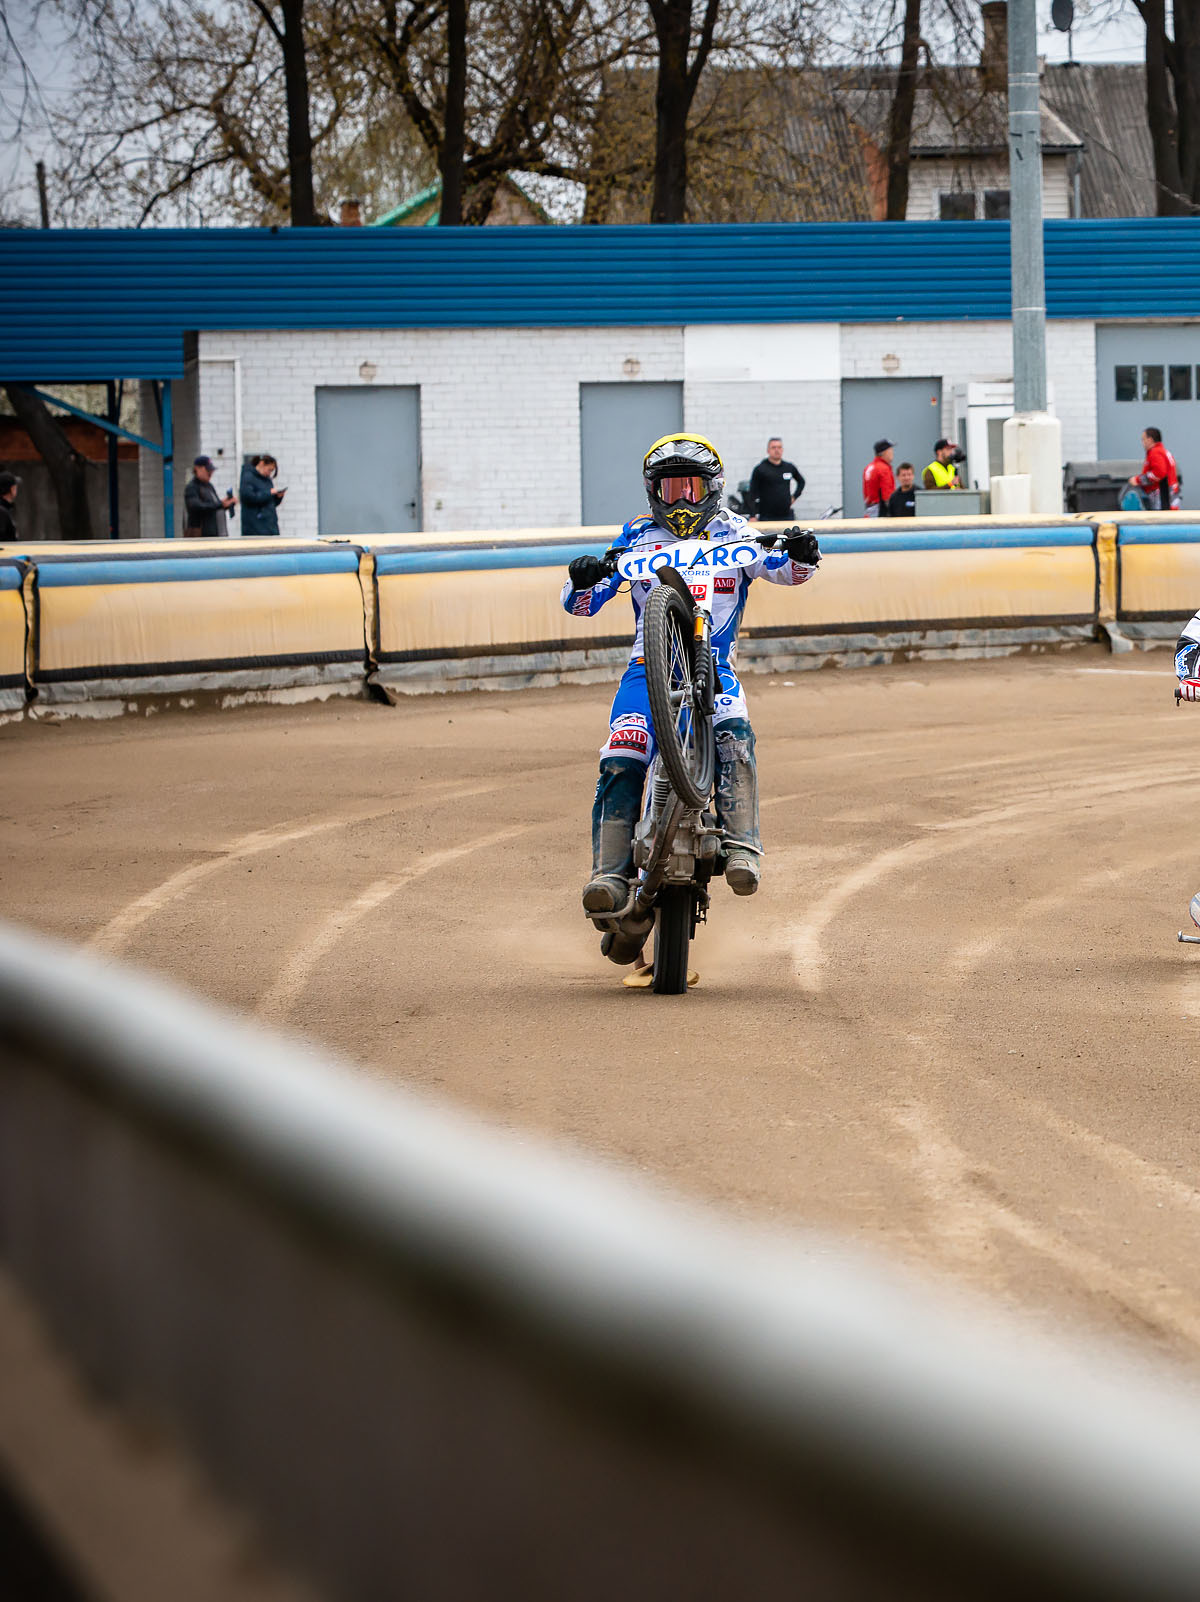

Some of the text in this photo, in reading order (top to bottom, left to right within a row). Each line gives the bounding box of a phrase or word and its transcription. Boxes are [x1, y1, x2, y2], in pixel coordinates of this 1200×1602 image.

[679, 569, 710, 577] XORIS
[714, 578, 734, 588] AMD
[612, 731, 647, 744] AMD
